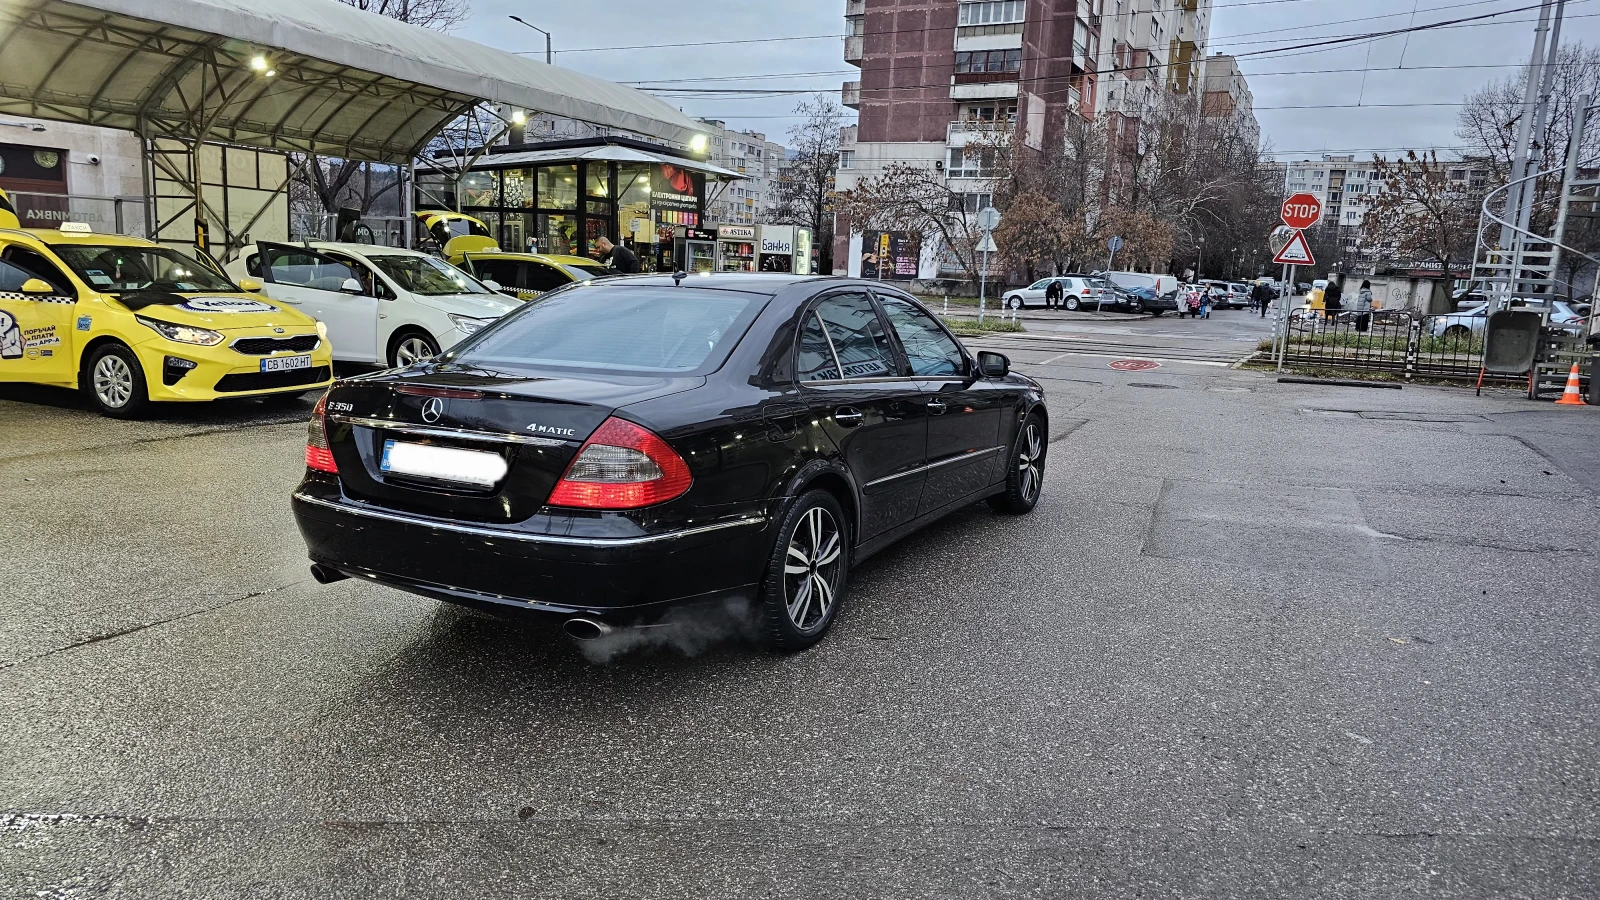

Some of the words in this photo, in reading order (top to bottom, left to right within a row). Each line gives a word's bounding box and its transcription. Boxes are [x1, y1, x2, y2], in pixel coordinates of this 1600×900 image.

[1284, 204, 1318, 218] STOP
[762, 238, 790, 252] Банкя
[24, 324, 56, 336] ПОРЪЧАЙ
[32, 332, 54, 340] ПЛАТИ
[267, 360, 278, 370] CB
[282, 358, 300, 368] 1602
[300, 356, 310, 366] HT
[328, 402, 334, 410] E
[334, 402, 353, 411] 350
